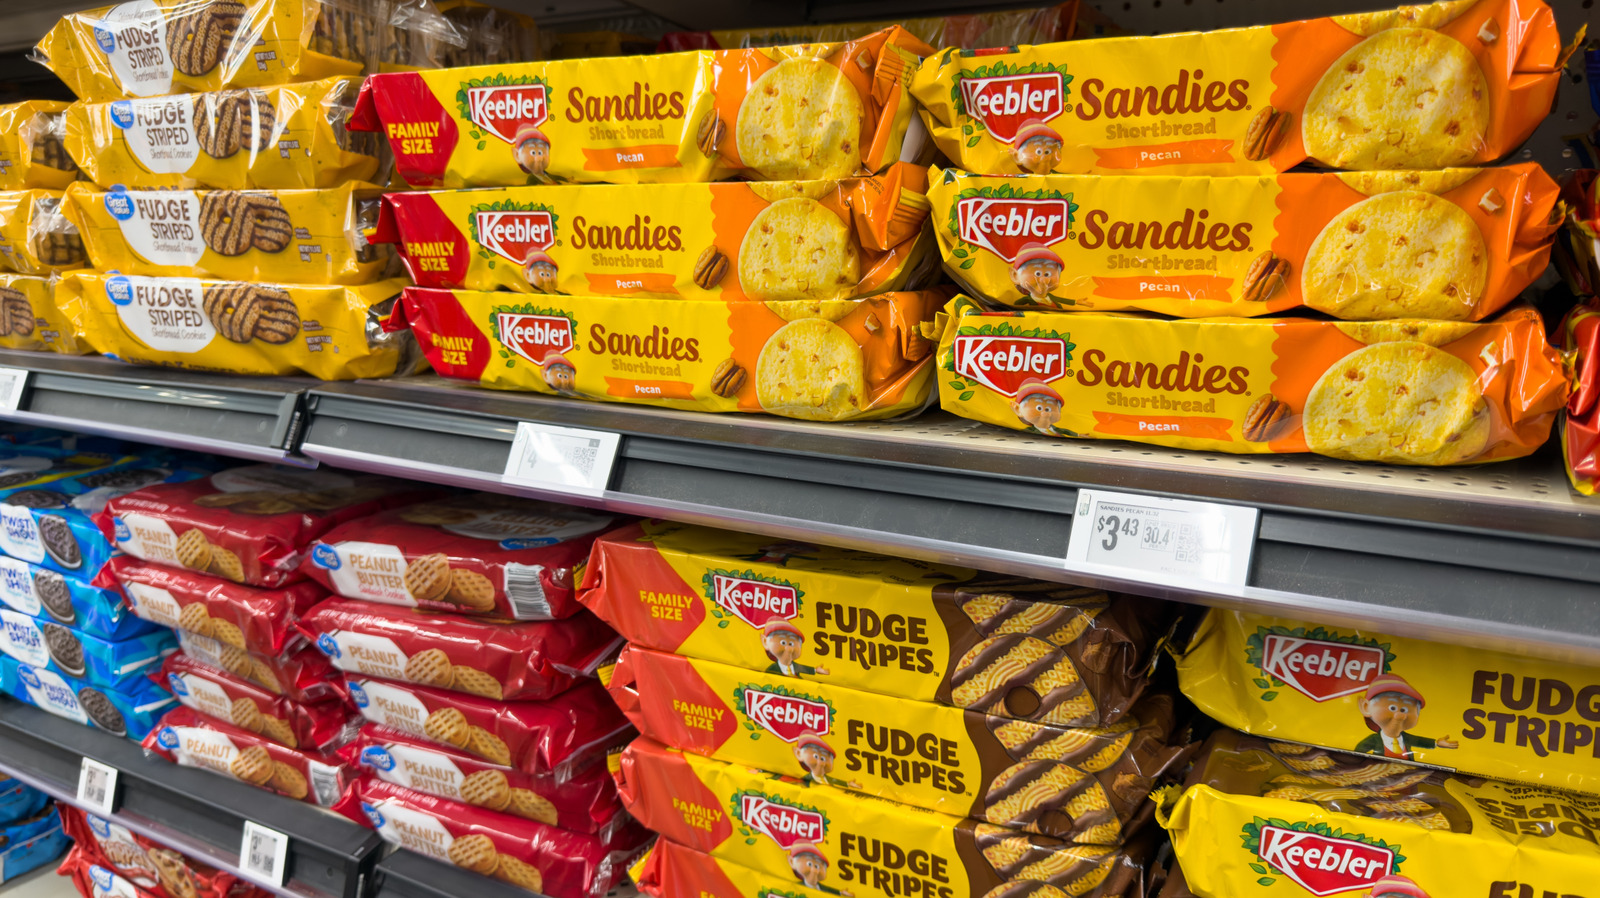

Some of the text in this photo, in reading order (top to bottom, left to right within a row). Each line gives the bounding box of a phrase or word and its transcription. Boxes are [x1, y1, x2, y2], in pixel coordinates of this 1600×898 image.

[116, 20, 160, 49] FUDGE
[128, 46, 164, 69] STRIPED
[470, 85, 544, 121] Keebler
[565, 81, 685, 123] Sandies
[966, 76, 1057, 117] Keebler
[1075, 69, 1249, 121] Sandies
[137, 102, 186, 126] FUDGE
[146, 127, 189, 147] STRIPED
[387, 121, 439, 139] FAMILY
[590, 123, 665, 141] Shortbread
[1106, 118, 1217, 141] Shortbread
[401, 138, 433, 155] SIZE
[616, 151, 644, 163] Pecan
[1140, 148, 1181, 162] Pecan
[107, 196, 129, 209] Great
[136, 199, 191, 221] FUDGE
[150, 222, 194, 241] STRIPED
[479, 211, 551, 245] Keebler
[964, 201, 1062, 240] Keebler
[1078, 208, 1253, 251] Sandies
[570, 213, 682, 252] Sandies
[406, 241, 455, 259] FAMILY
[591, 252, 664, 269] Shortbread
[420, 256, 450, 271] SIZE
[1107, 254, 1217, 272] Shortbread
[108, 280, 129, 293] Great
[616, 278, 643, 290] Pecan
[1139, 281, 1180, 294] Pecan
[136, 286, 197, 308] FUDGE
[148, 309, 203, 327] STRIPED
[501, 314, 569, 346] Keebler
[588, 323, 700, 362] Sandies
[442, 349, 468, 365] SIZE
[960, 337, 1059, 374] Keebler
[612, 358, 682, 377] Shortbread
[1076, 348, 1249, 395] Sandies
[634, 384, 661, 395] Pecan
[1107, 391, 1215, 413] Shortbread
[1138, 420, 1180, 432] Pecan
[1100, 505, 1124, 513] SANDIES
[135, 527, 171, 546] PEANUT
[350, 554, 399, 573] PEANUT
[356, 571, 404, 590] BUTTER
[140, 595, 175, 617] PEANUT
[639, 590, 694, 610] FAMILY
[718, 578, 792, 614] Keebler
[651, 605, 683, 621] SIZE
[815, 601, 929, 645] FUDGE
[348, 645, 399, 667] PEANUT
[813, 631, 934, 675] STRIPES
[1267, 635, 1377, 682] Keebler
[357, 661, 403, 679] BUTTER
[375, 697, 420, 721] PEANUT
[673, 699, 724, 721] FAMILY
[748, 692, 825, 730] Keebler
[684, 714, 715, 732] SIZE
[187, 738, 231, 759] PEANUT
[847, 718, 960, 768] FUDGE
[404, 760, 456, 783] PEANUT
[844, 748, 966, 795] STRIPES
[410, 776, 457, 797] BUTTER
[672, 797, 722, 823] FAMILY
[743, 797, 819, 838] Keebler
[393, 819, 445, 845] PEANUT
[684, 812, 713, 833] SIZE
[400, 834, 447, 857] BUTTER
[1264, 826, 1385, 879] Keebler
[839, 832, 950, 884] FUDGE
[838, 858, 954, 898] STRIPES
